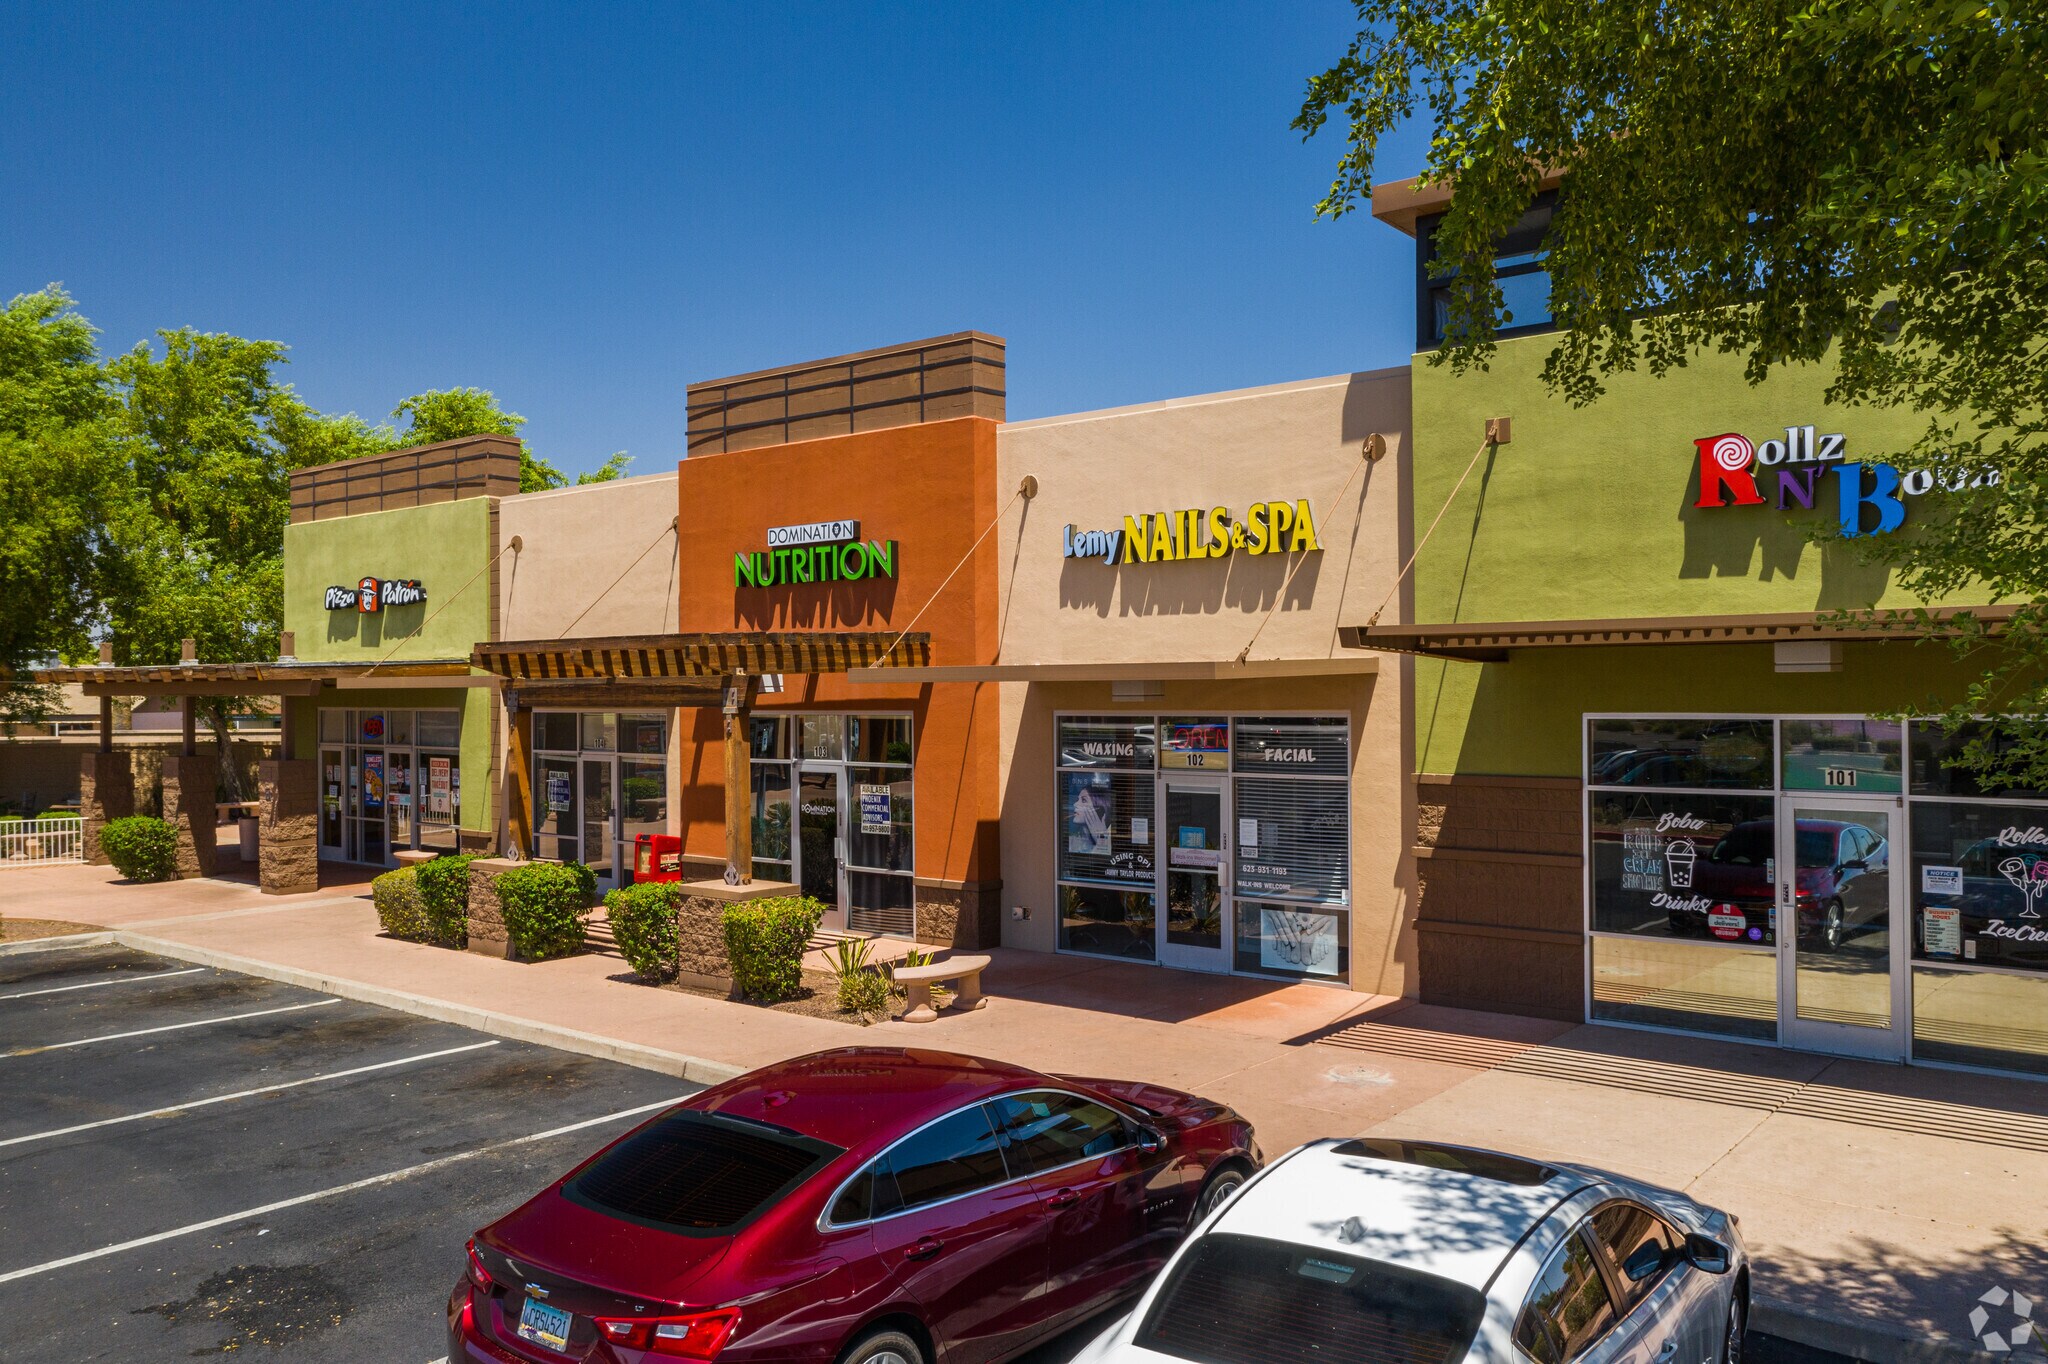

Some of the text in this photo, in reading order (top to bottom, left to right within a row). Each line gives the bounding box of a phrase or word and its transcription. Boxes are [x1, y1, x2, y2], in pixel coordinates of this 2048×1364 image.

[1693, 425, 1847, 508] Rollz
[1064, 499, 1319, 566] Lemy NAILS & SPA
[735, 540, 893, 588] NUTRITION
[325, 580, 420, 609] Pizza Patrón
[1174, 727, 1228, 749] OPEN
[814, 746, 827, 757] 103
[1083, 741, 1135, 757] WAXING
[1264, 747, 1317, 763] FACIAL
[1186, 754, 1204, 766] 102
[431, 768, 448, 777] DELIVERY
[1827, 770, 1855, 786] 101
[862, 785, 889, 794] AVAILABLE
[862, 795, 881, 803] PHOENIX
[862, 804, 889, 813] COMMERCIAL
[863, 813, 883, 822] ADVISORS
[1655, 812, 1708, 833] Boba
[1110, 852, 1151, 869] USING OPI
[1128, 861, 1134, 869] &
[1623, 857, 1663, 874] CREAM
[1120, 869, 1135, 878] TAYLOR
[1135, 871, 1156, 880] PRODUCTS
[1242, 864, 1287, 875] 623-931-1193
[1236, 880, 1291, 890] WALK-INS WELCOME
[1649, 892, 1713, 914] Drinks
